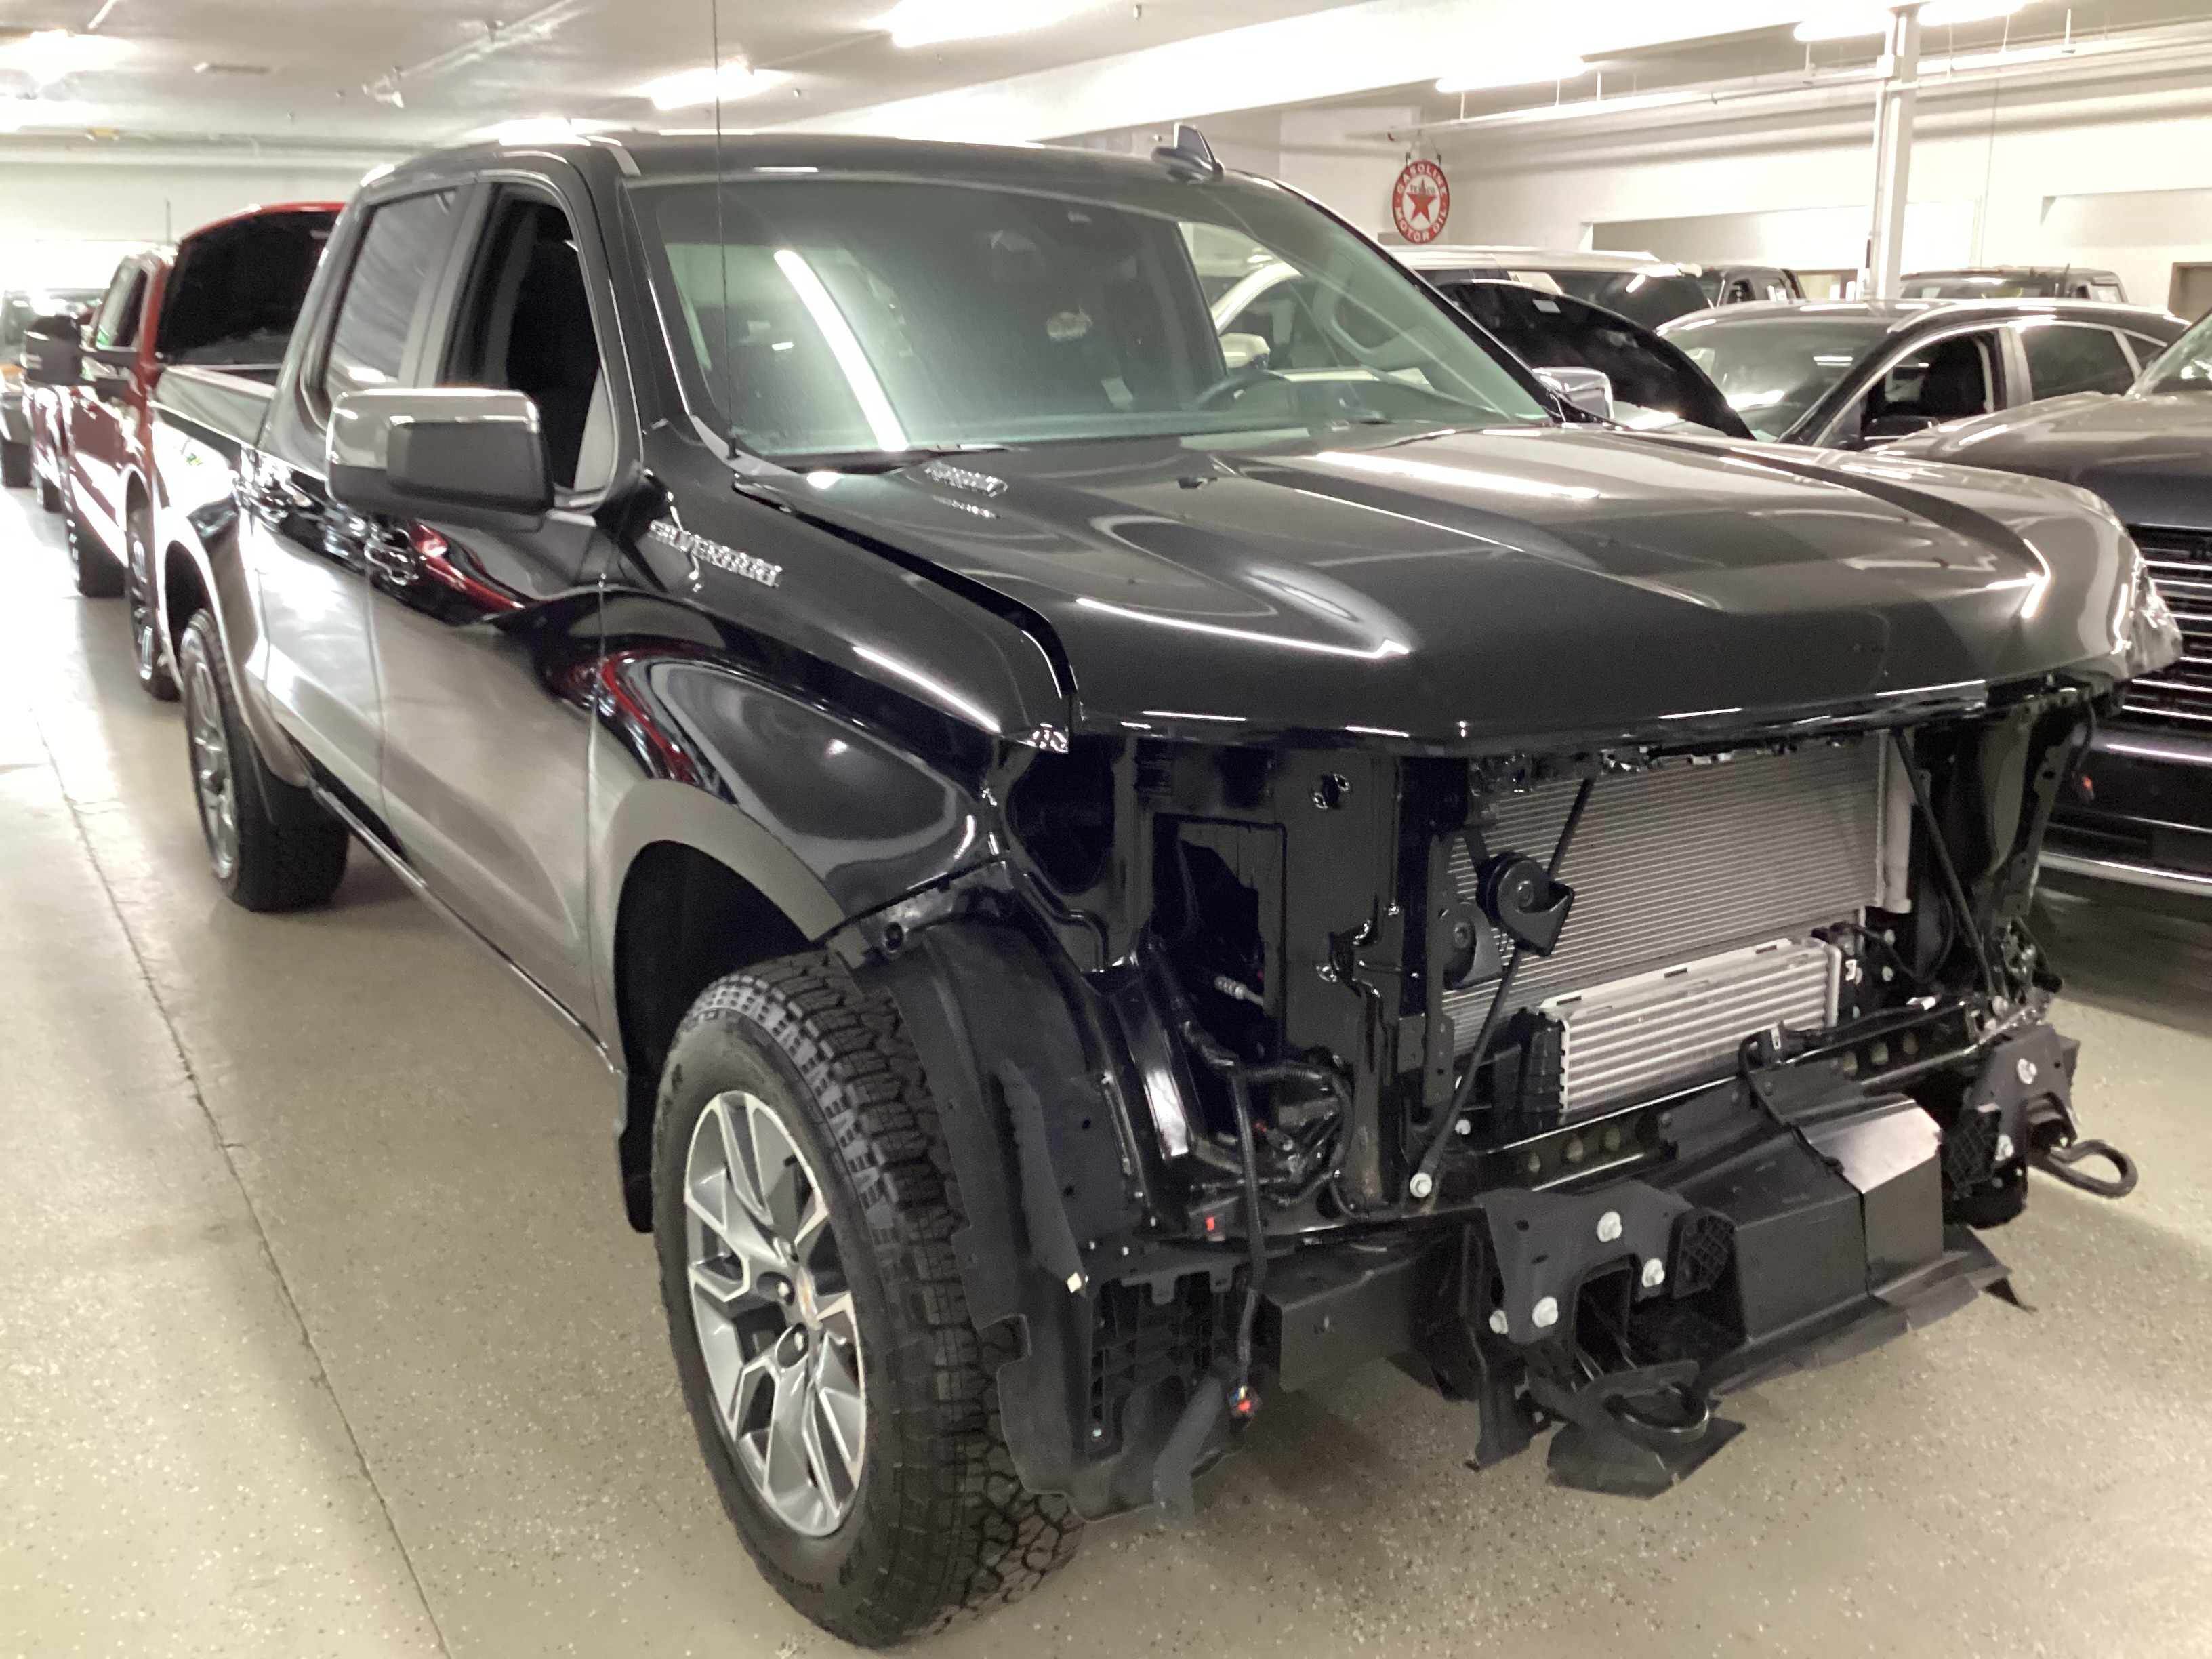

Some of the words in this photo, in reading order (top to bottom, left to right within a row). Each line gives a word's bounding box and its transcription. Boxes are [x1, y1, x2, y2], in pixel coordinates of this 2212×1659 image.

[1397, 163, 1448, 196] GASOLINE
[1395, 207, 1431, 242] MOTOR
[1433, 209, 1447, 234] OIL
